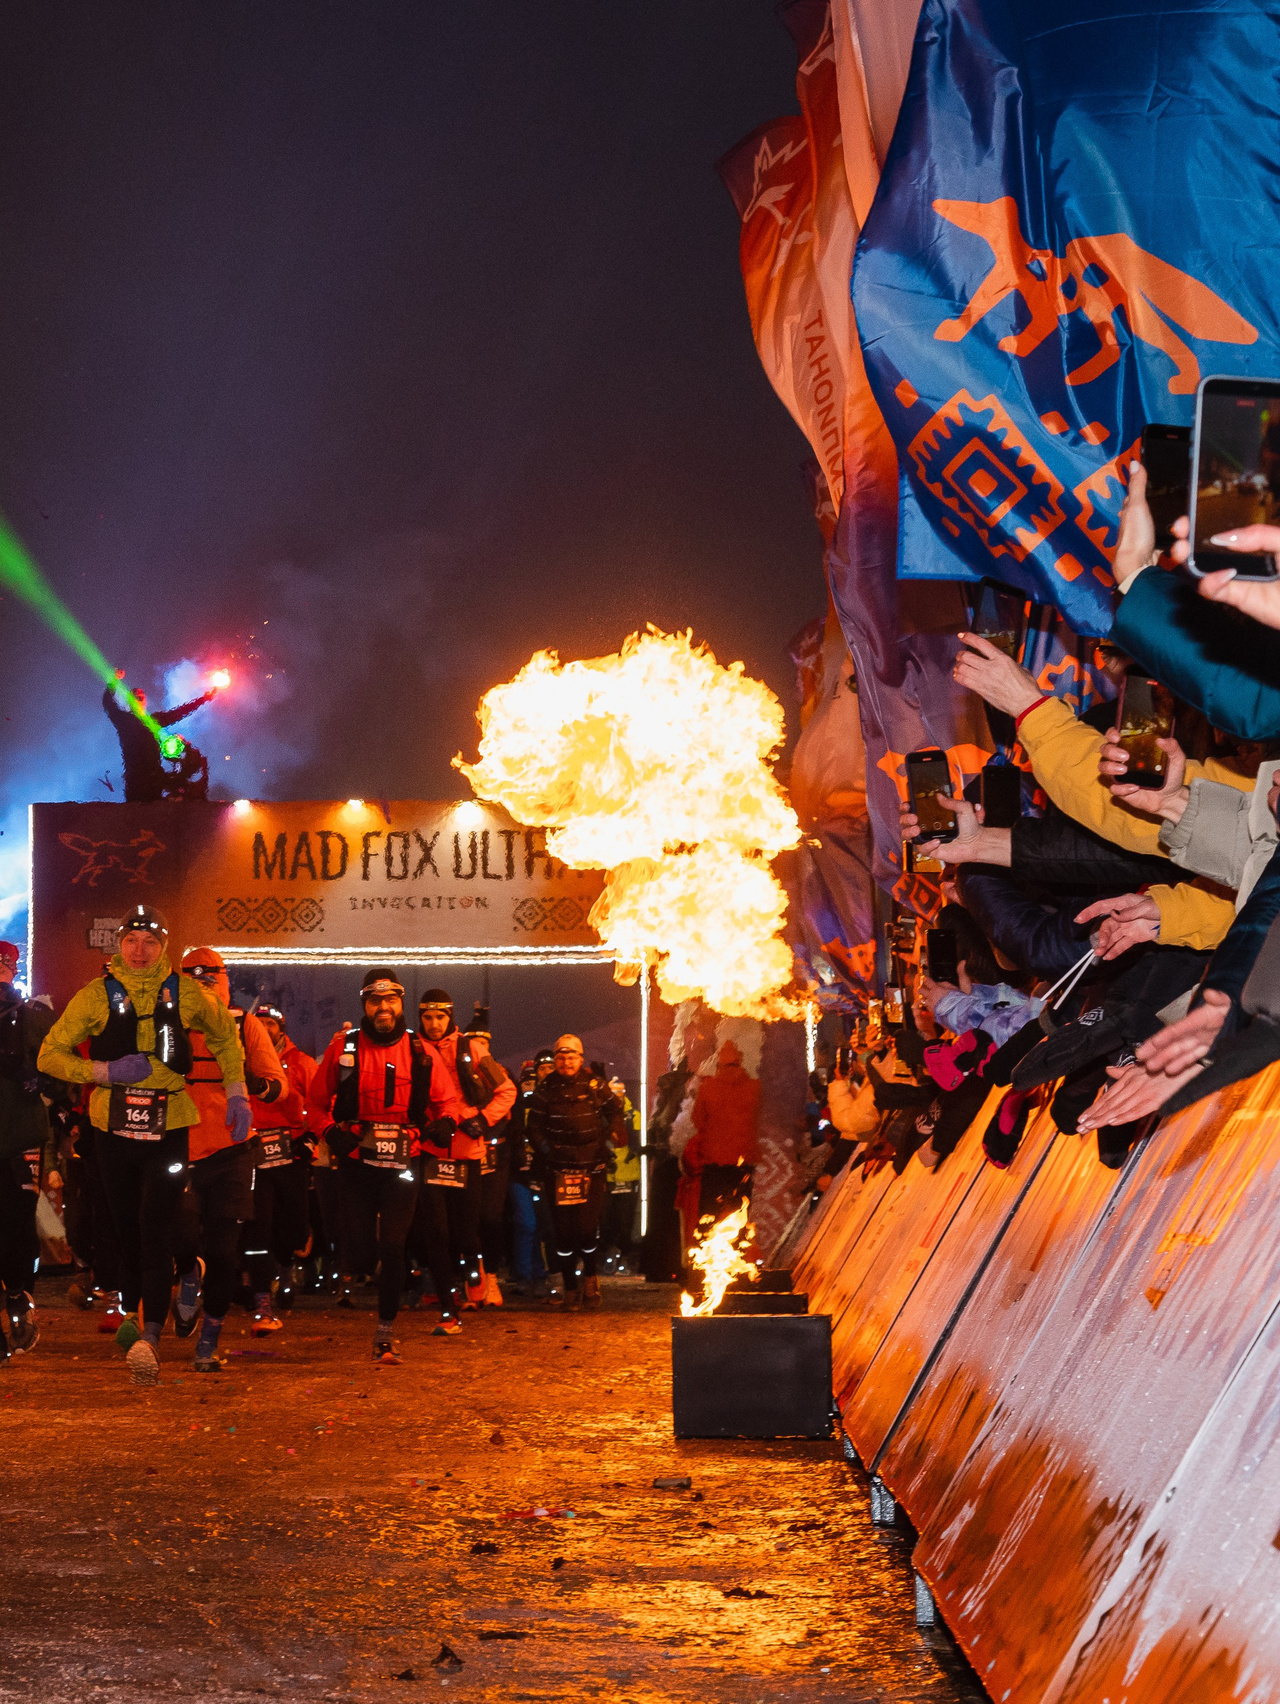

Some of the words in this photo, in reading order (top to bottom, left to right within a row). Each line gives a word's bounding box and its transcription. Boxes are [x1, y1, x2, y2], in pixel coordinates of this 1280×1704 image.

[253, 830, 348, 881] MAD
[361, 829, 441, 881] FOX
[452, 829, 583, 881] ULTR
[125, 1108, 150, 1122] 164
[263, 1143, 281, 1155] 134
[375, 1141, 397, 1154] 190
[437, 1163, 455, 1174] 142
